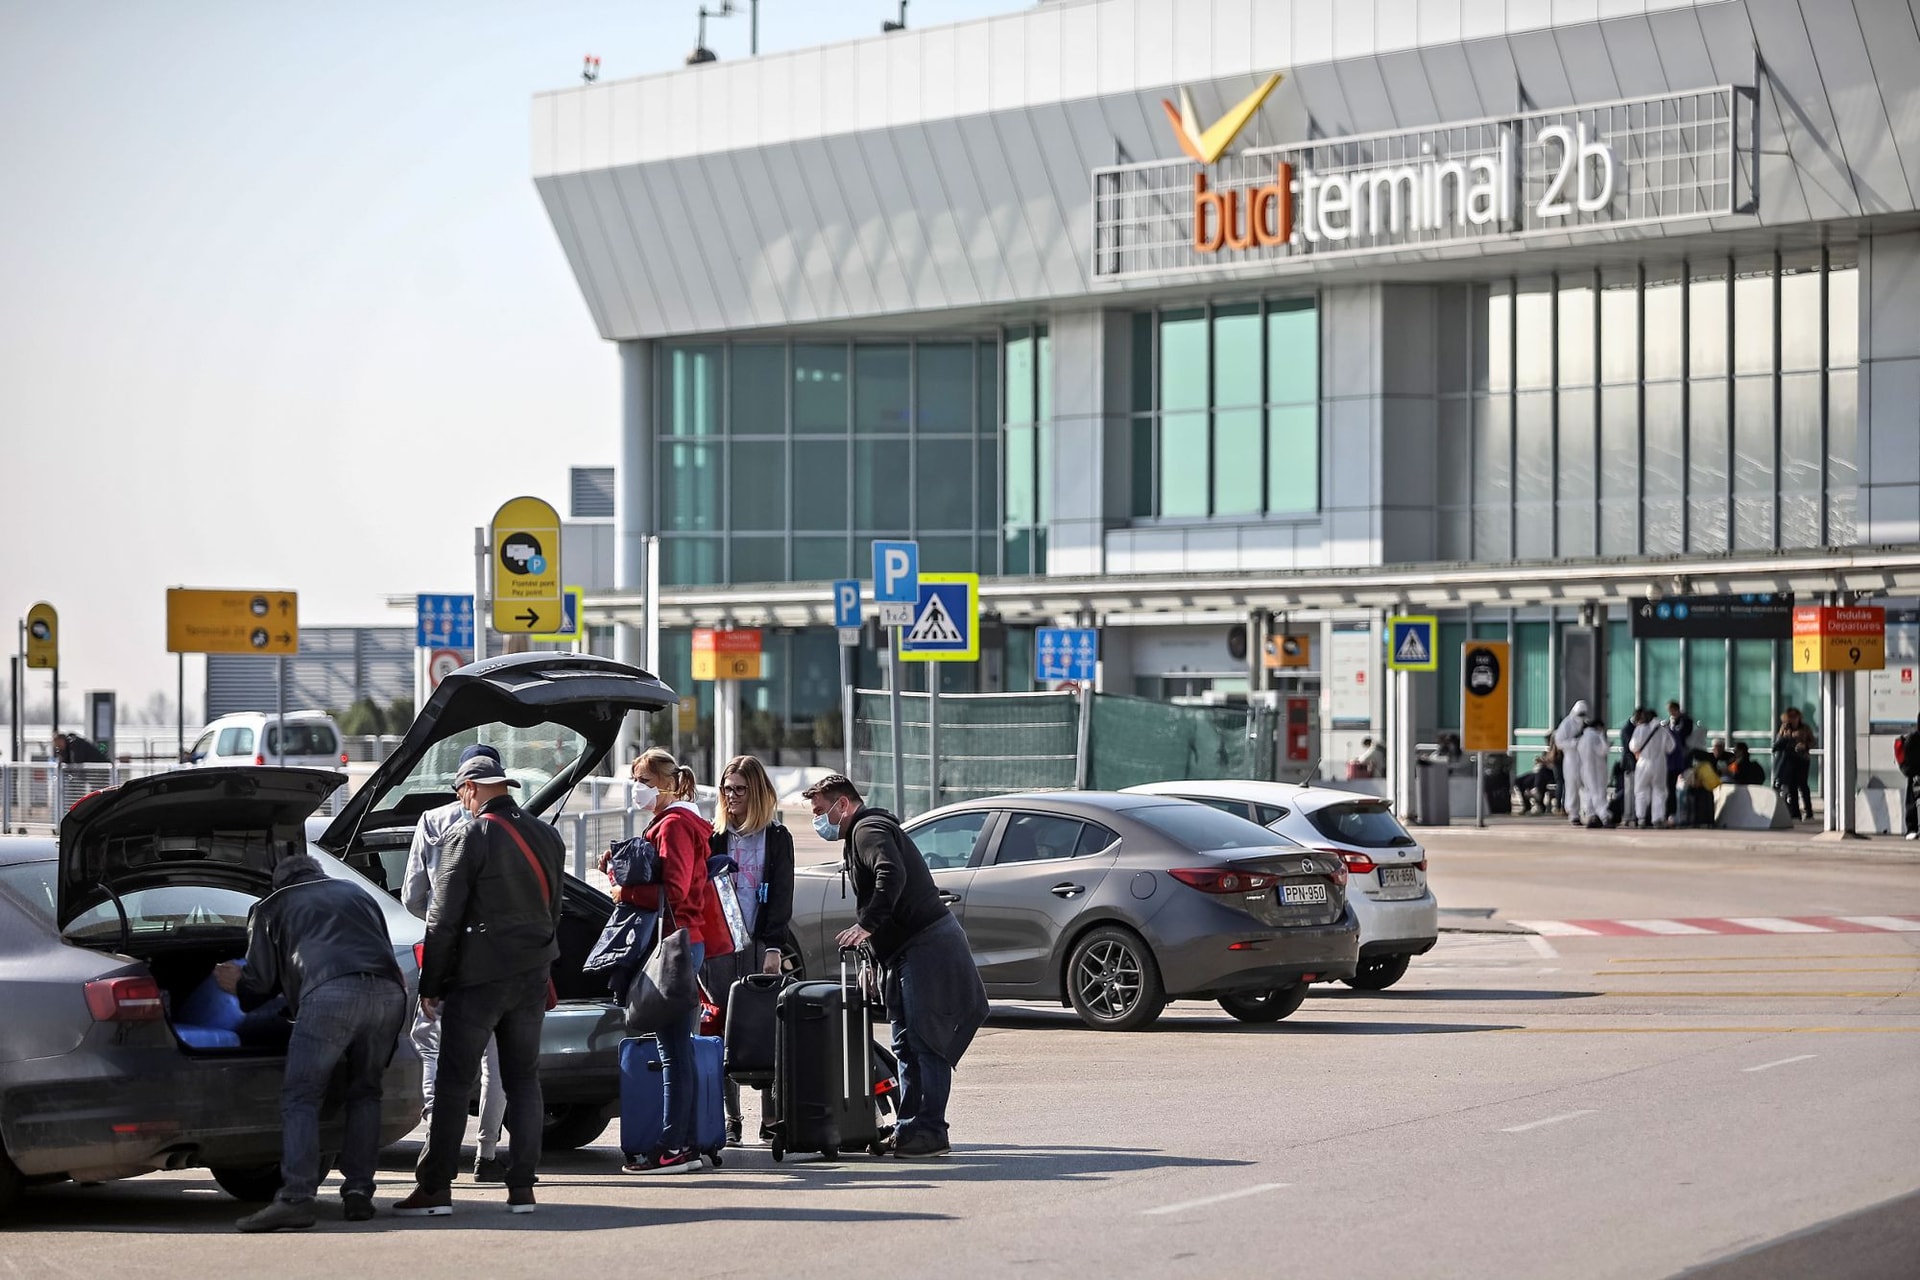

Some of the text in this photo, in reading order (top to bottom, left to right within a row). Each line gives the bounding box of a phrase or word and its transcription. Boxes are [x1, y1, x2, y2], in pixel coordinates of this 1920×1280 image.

[1535, 121, 1617, 218] 2b
[885, 549, 909, 595] P
[840, 586, 856, 622] P
[1836, 609, 1872, 620] Indulás
[1827, 621, 1881, 632] Departures
[1804, 647, 1810, 664] 9
[1849, 647, 1861, 665] 9
[1285, 886, 1325, 901] PPN-950
